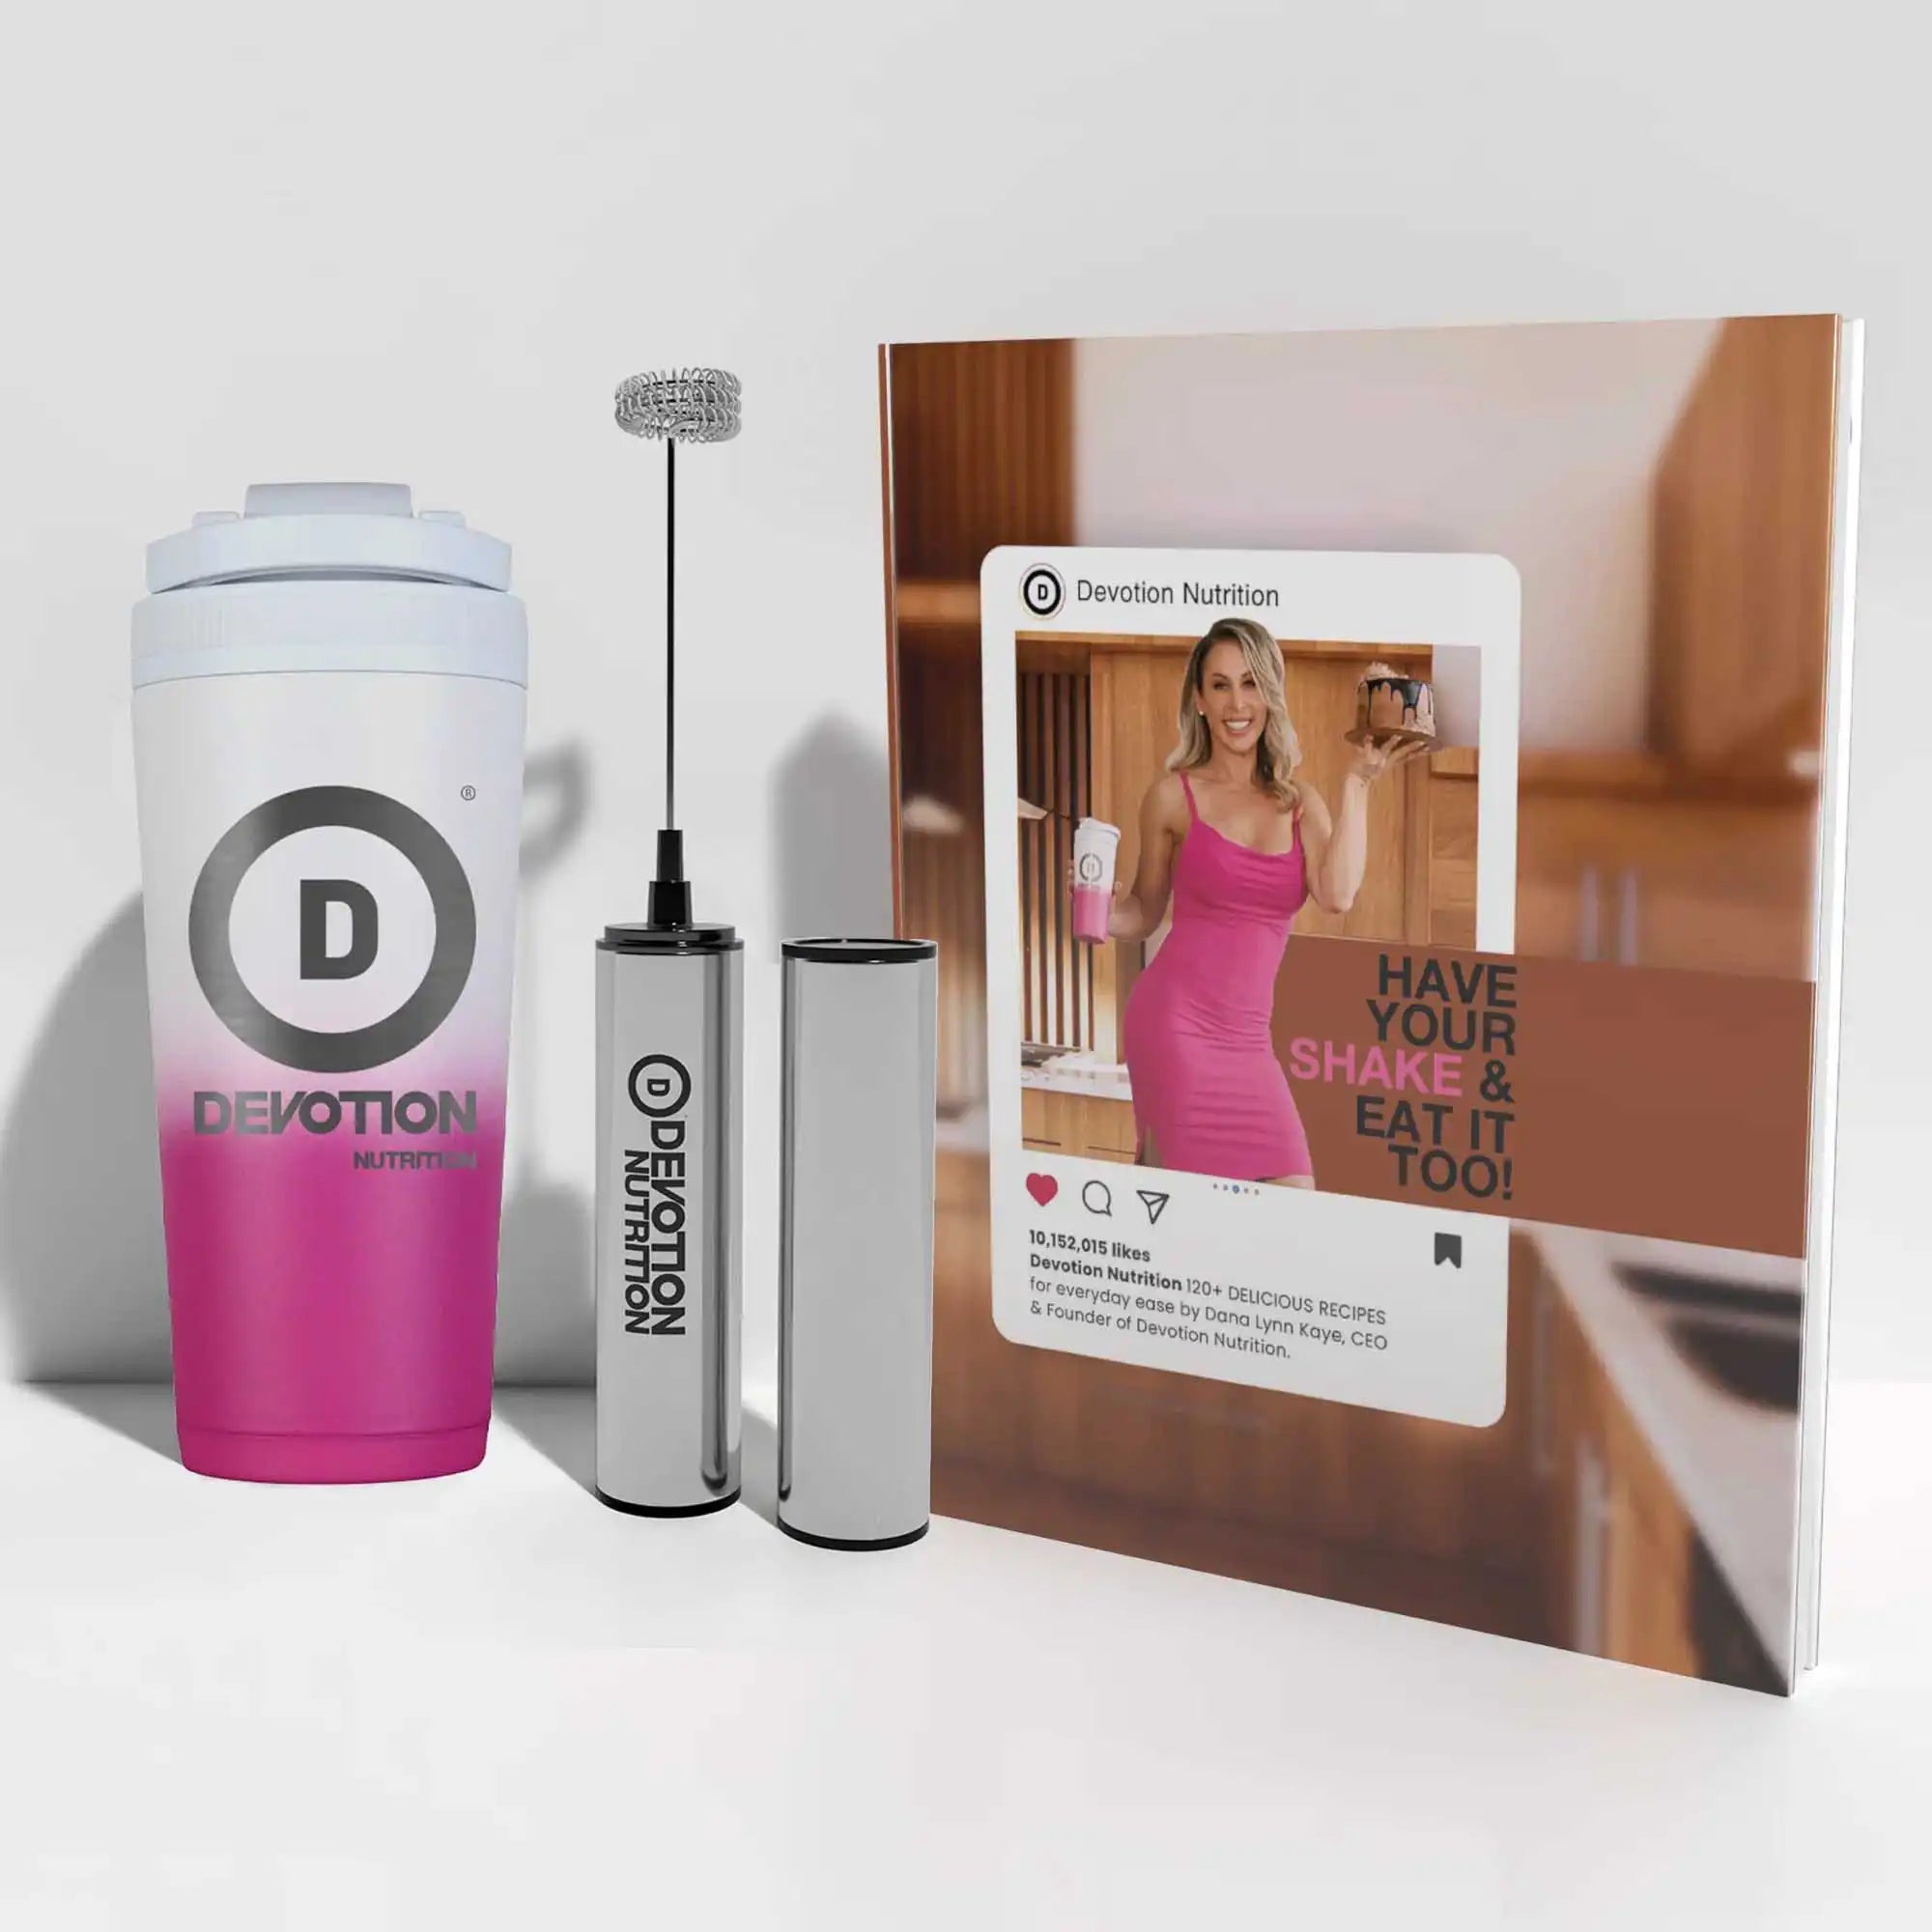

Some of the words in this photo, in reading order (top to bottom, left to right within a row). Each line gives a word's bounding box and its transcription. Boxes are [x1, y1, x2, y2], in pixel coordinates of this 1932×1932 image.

[1037, 583, 1048, 601] D
[1077, 579, 1174, 604] Devotion
[1183, 582, 1279, 607] Nutrition
[299, 878, 379, 980] D
[1378, 953, 1518, 1009] HAVE
[1366, 999, 1516, 1056] YOUR
[647, 1078, 670, 1096] D
[1290, 1036, 1463, 1097] SHAKE
[1479, 1059, 1515, 1104] &
[193, 1090, 476, 1135] DEVOTION
[1356, 1094, 1454, 1146] EAT
[1470, 1108, 1515, 1153] IT
[353, 1150, 478, 1170] NUTRITION
[1388, 1143, 1513, 1201] TOO!
[624, 1149, 650, 1335] NUTRITION
[650, 1120, 686, 1335] DEVOTION
[1029, 1229, 1108, 1255] 10,152,015
[1112, 1241, 1151, 1263] likes
[1030, 1253, 1103, 1278] Devotion
[1107, 1266, 1182, 1292] Nutrition
[1186, 1277, 1222, 1296] 120+
[1228, 1285, 1314, 1314] DELICIOUS
[1319, 1300, 1386, 1325] RECIPES
[1030, 1276, 1052, 1293] for
[1056, 1281, 1131, 1310] everyday
[1135, 1296, 1175, 1315] ease
[1179, 1300, 1200, 1322] by
[1206, 1306, 1250, 1327] Dana
[1255, 1314, 1294, 1335] Lynn
[1299, 1321, 1346, 1346] Kaye,
[1351, 1330, 1388, 1350] CEO
[1030, 1300, 1042, 1316] &
[1047, 1302, 1112, 1327] Founder
[1116, 1316, 1132, 1330] of
[1136, 1318, 1208, 1346] Devotion
[1213, 1331, 1292, 1359] Nutrition.
